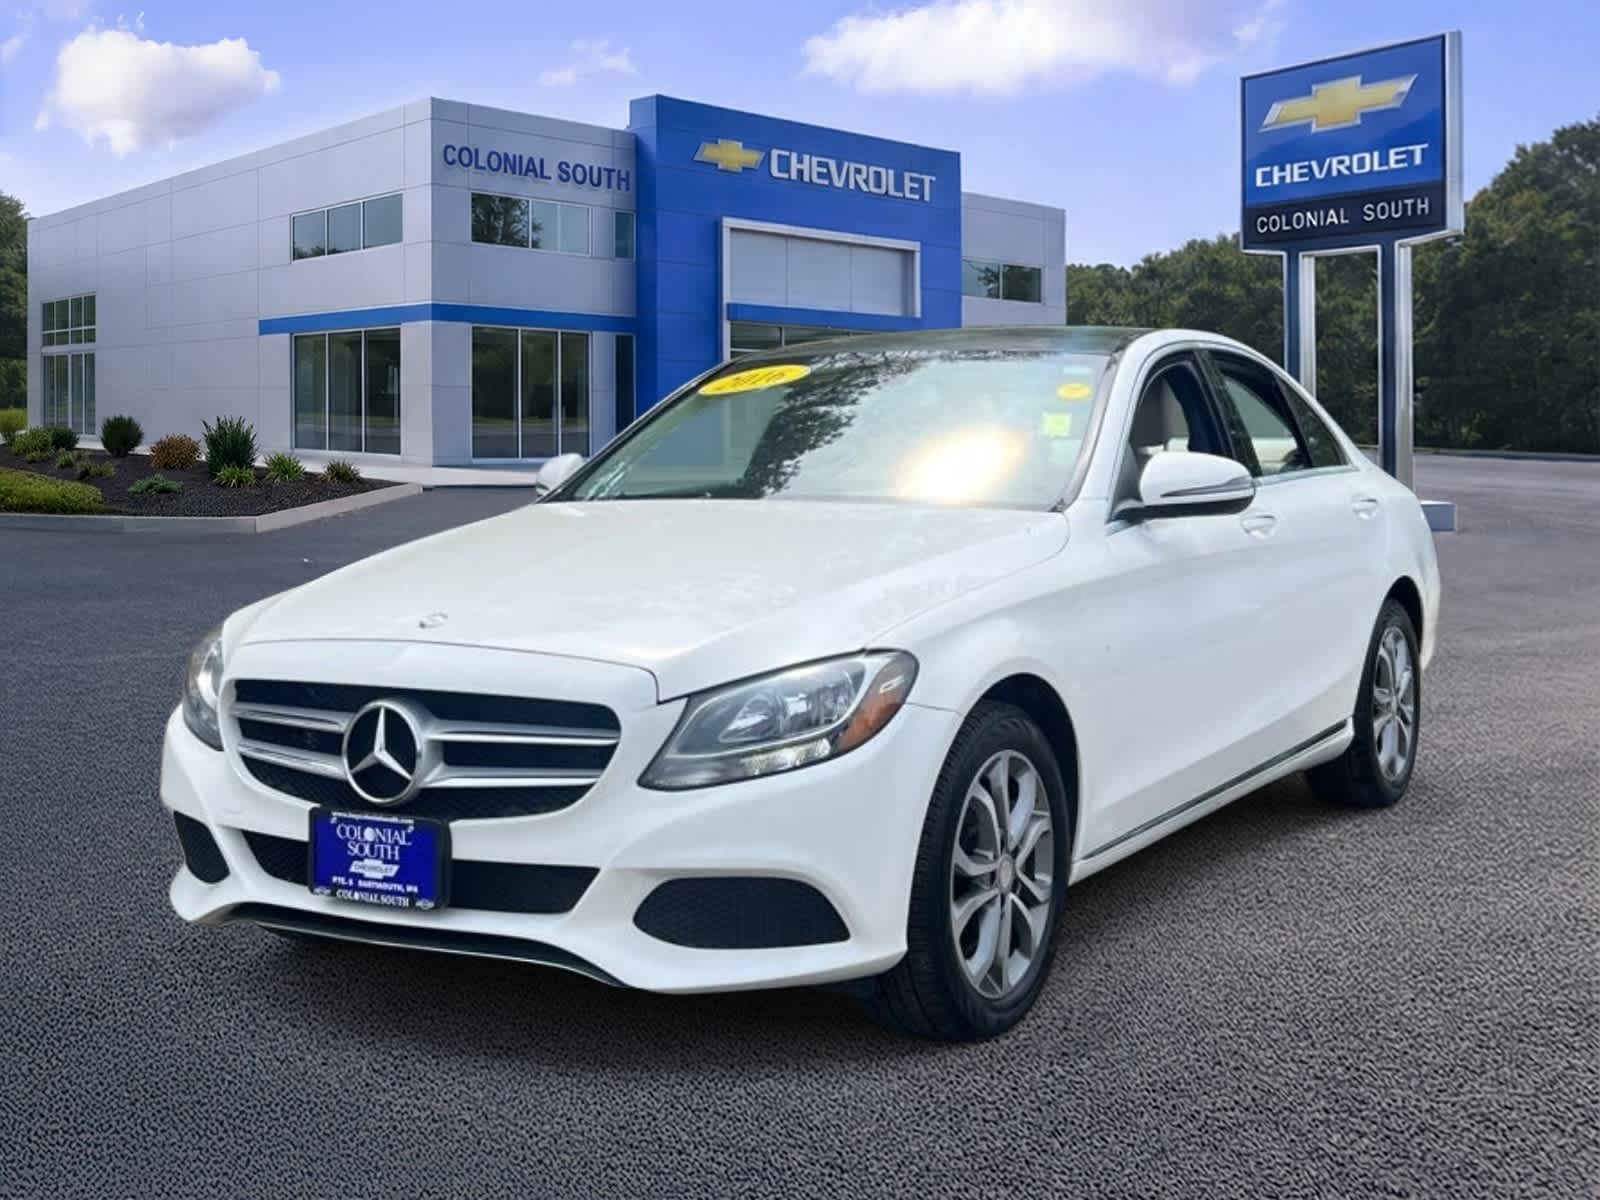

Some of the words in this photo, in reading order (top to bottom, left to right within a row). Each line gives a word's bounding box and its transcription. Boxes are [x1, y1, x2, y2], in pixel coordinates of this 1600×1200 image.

[443, 144, 552, 180] COLONIAL
[557, 161, 630, 192] SOUTH
[770, 148, 936, 202] CHEVROLET
[1255, 143, 1429, 187] CHEVROLET
[1256, 208, 1349, 233] COLONIAL
[1362, 197, 1429, 221] SOUTH
[336, 823, 412, 845] COLONIAL
[347, 841, 400, 861] SOUTH
[336, 889, 379, 903] COLONIAL
[380, 896, 409, 907] SOUTH
